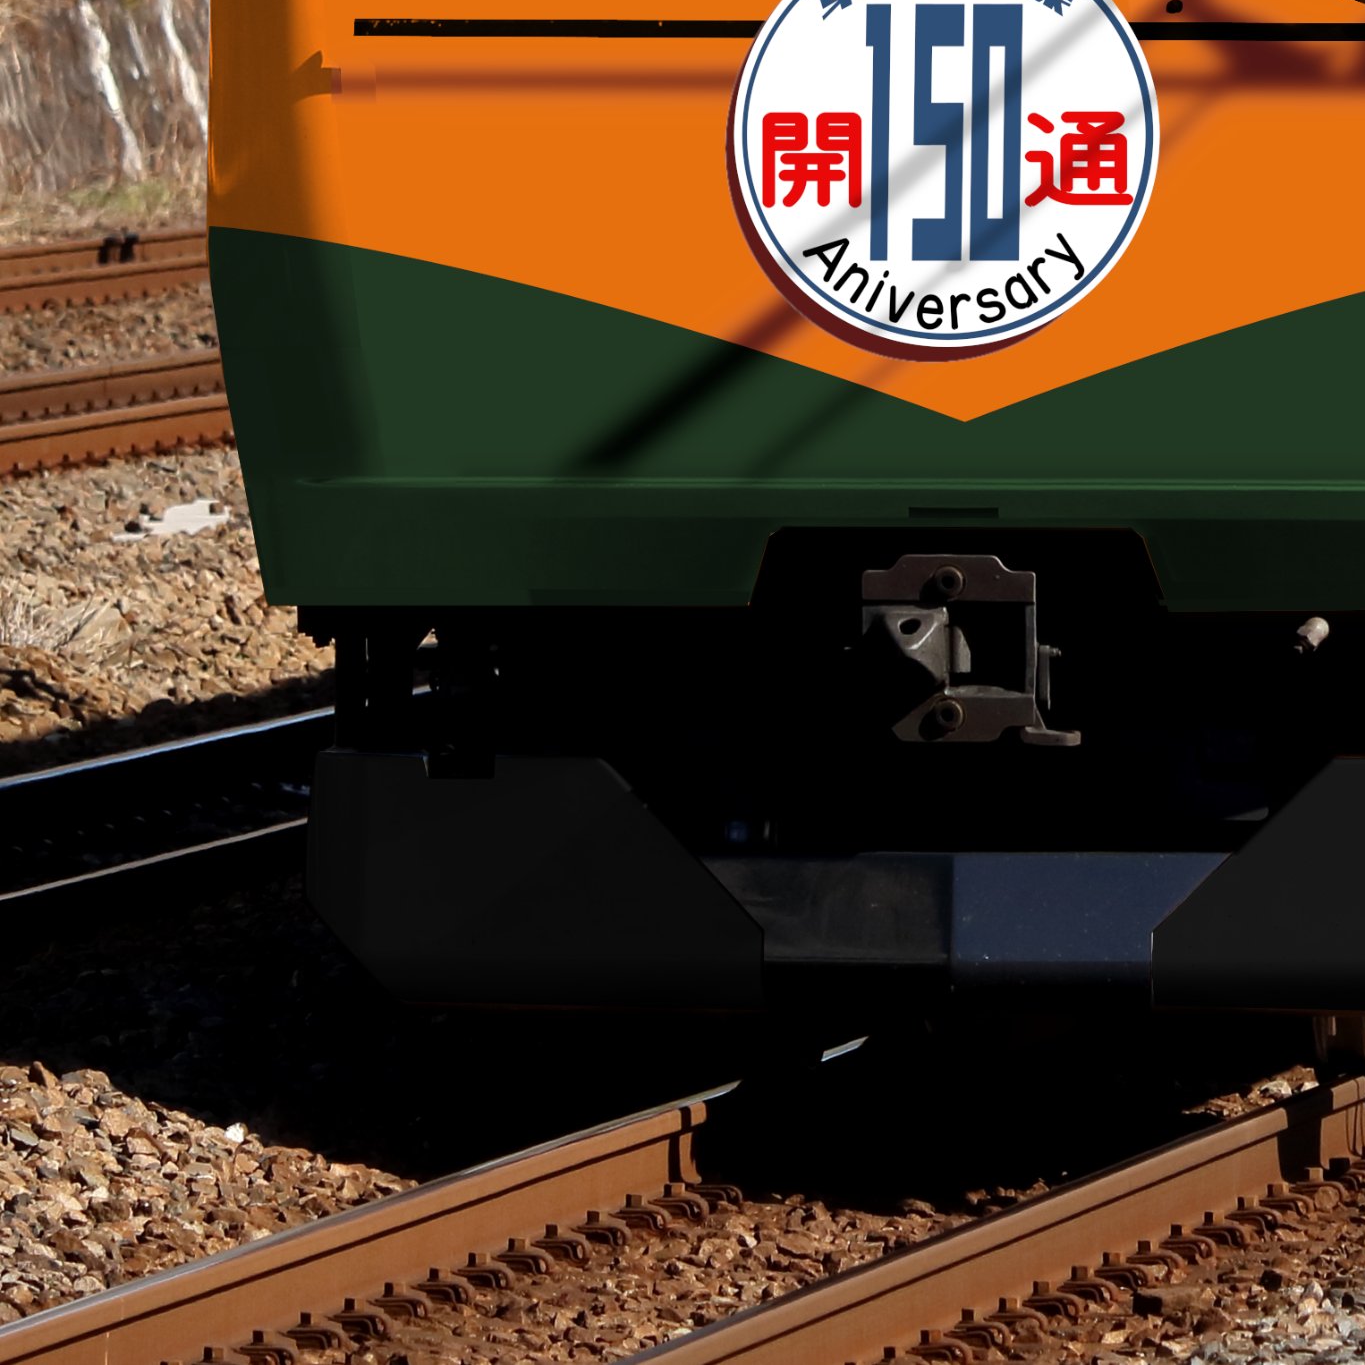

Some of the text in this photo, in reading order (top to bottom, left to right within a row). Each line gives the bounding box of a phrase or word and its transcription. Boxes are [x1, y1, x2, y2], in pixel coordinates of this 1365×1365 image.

[762, 4, 1134, 261] 開 150 通
[803, 233, 1085, 330] Aniversary
